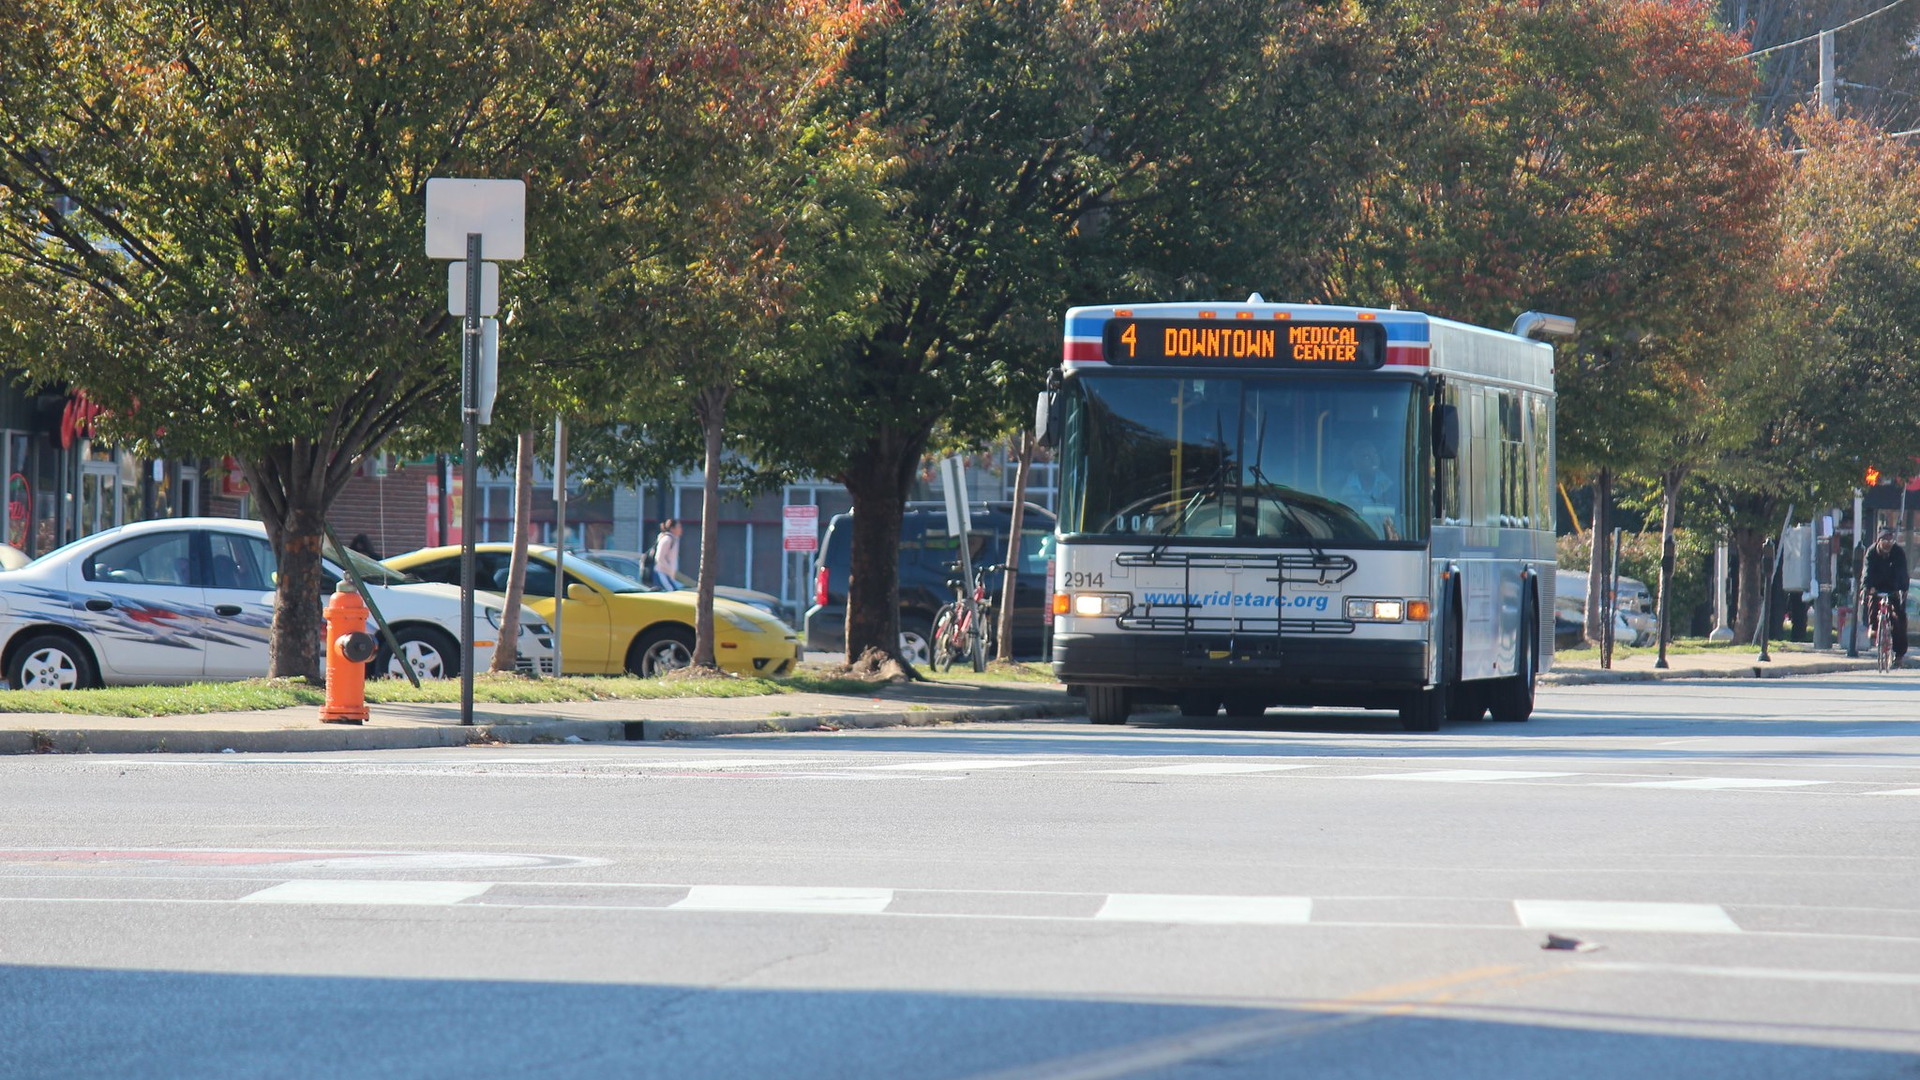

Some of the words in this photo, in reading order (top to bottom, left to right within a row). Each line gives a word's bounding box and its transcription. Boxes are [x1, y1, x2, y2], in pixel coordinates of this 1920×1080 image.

[1121, 323, 1136, 357] 4
[1164, 327, 1275, 358] DOWNTOWN
[1289, 326, 1359, 345] MEDICAL
[1293, 344, 1356, 361] CENTER
[1064, 572, 1104, 588] 2914
[1144, 590, 1328, 611] www.ridetarc.org
